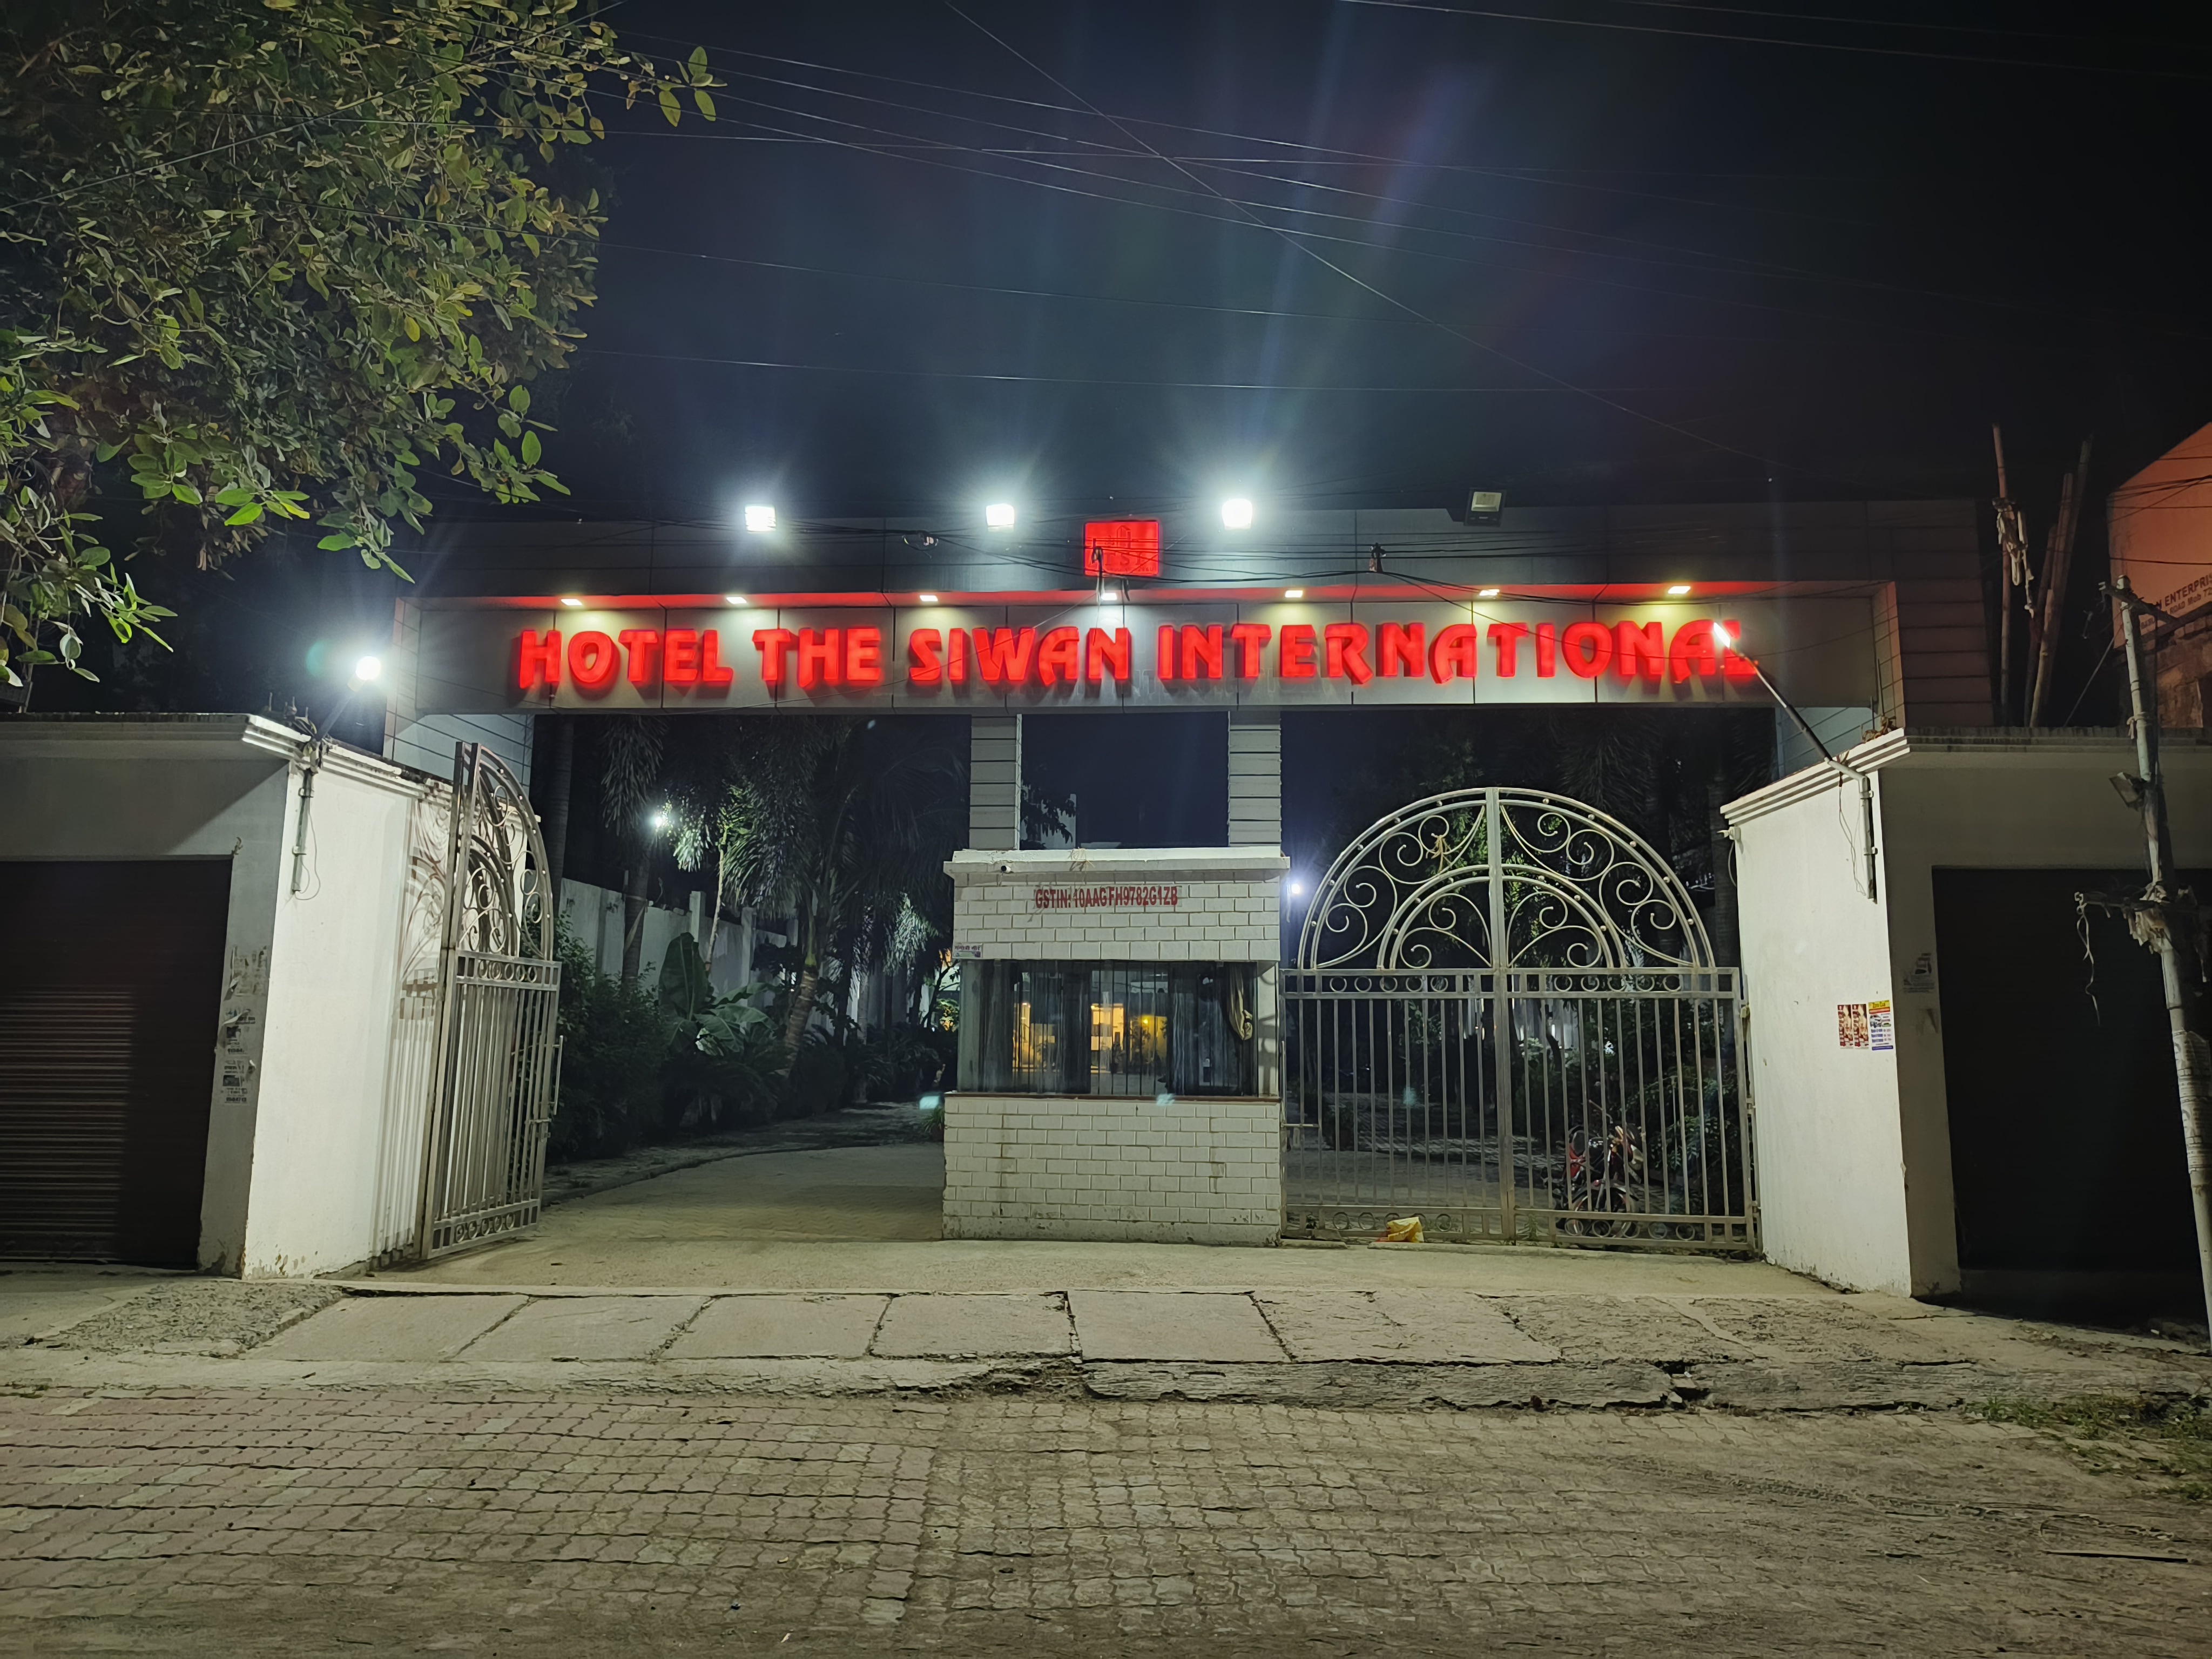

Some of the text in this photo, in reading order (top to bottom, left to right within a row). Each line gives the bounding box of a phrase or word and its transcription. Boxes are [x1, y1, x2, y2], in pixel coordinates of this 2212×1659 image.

[518, 629, 735, 688] HOTEL
[751, 628, 884, 687] THE
[909, 626, 1131, 686] SIWAN
[1157, 619, 1758, 686] INTERNATIONAL
[1035, 888, 1071, 908] GSTIN:
